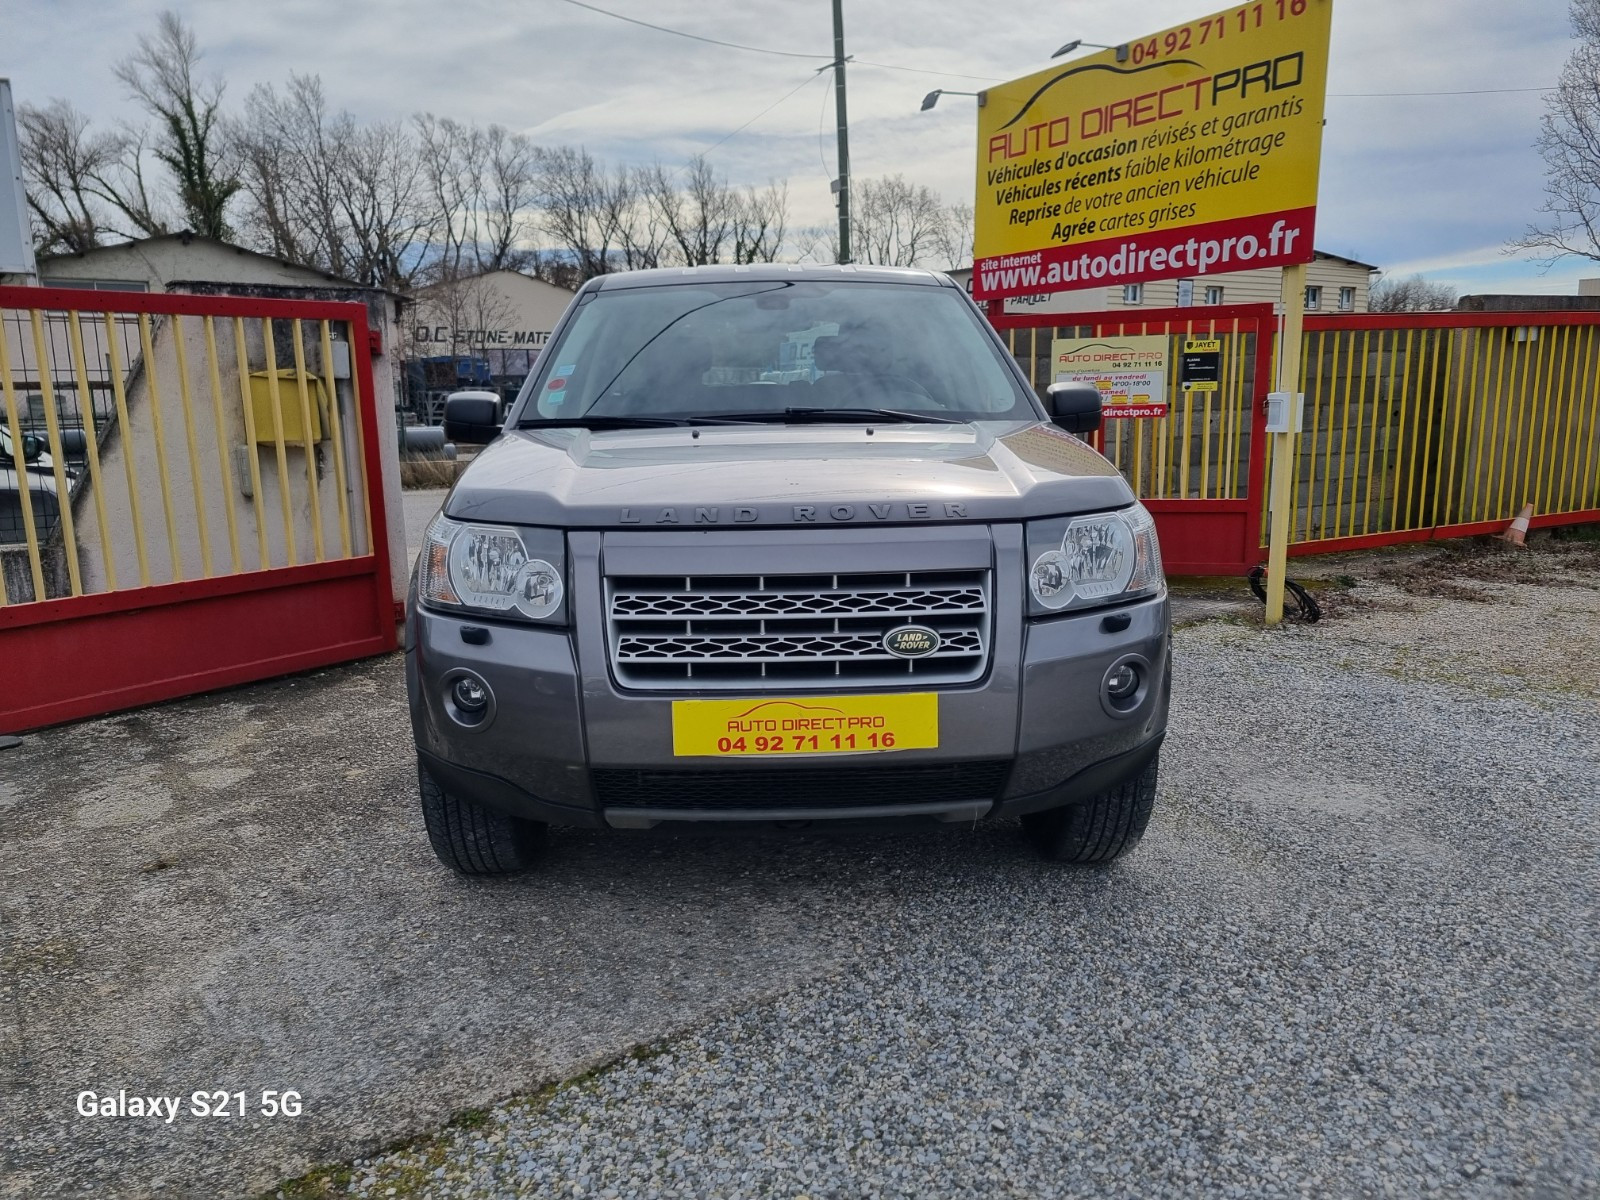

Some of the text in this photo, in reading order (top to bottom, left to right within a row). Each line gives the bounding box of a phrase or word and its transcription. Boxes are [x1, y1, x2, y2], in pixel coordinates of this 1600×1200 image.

[1132, 0, 1307, 65] 04 92 71 11 16
[987, 95, 1304, 186] Véhicules d'occasion révisés et garantis
[988, 116, 1070, 163] AUTO
[996, 131, 1286, 206] Véhicules récents faible kilométrage
[1009, 160, 1260, 226] Reprise de votre ancien véhicule
[1051, 202, 1197, 243] Agrée cartes grises
[980, 219, 1300, 292] www.autodirectpro.fr
[981, 252, 1042, 272] site internet
[1059, 354, 1091, 363] AUTO
[1101, 407, 1162, 417] directpro.fr
[619, 501, 968, 524] LAND ROVER
[717, 732, 896, 752] 04 92 71 11 16
[727, 719, 777, 733] AUTO
